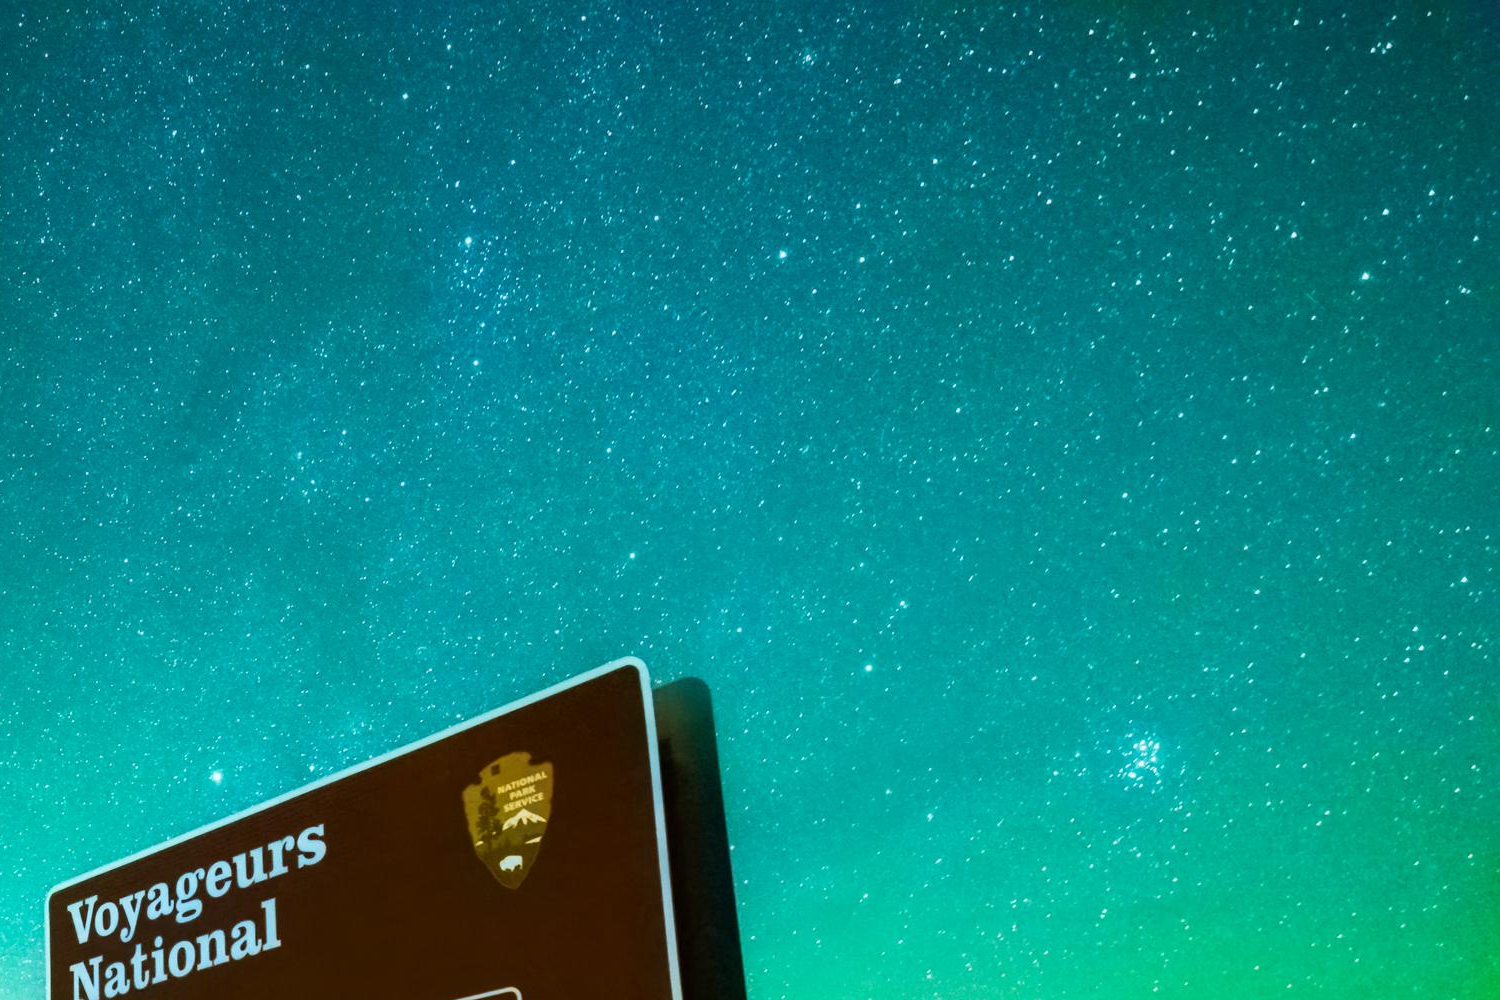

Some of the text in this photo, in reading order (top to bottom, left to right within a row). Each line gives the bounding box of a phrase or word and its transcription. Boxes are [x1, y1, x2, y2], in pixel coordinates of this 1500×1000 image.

[497, 771, 547, 794] NATIONAL
[509, 785, 536, 800] PARK
[503, 792, 544, 813] SERVICE
[67, 823, 327, 944] Voyageurs
